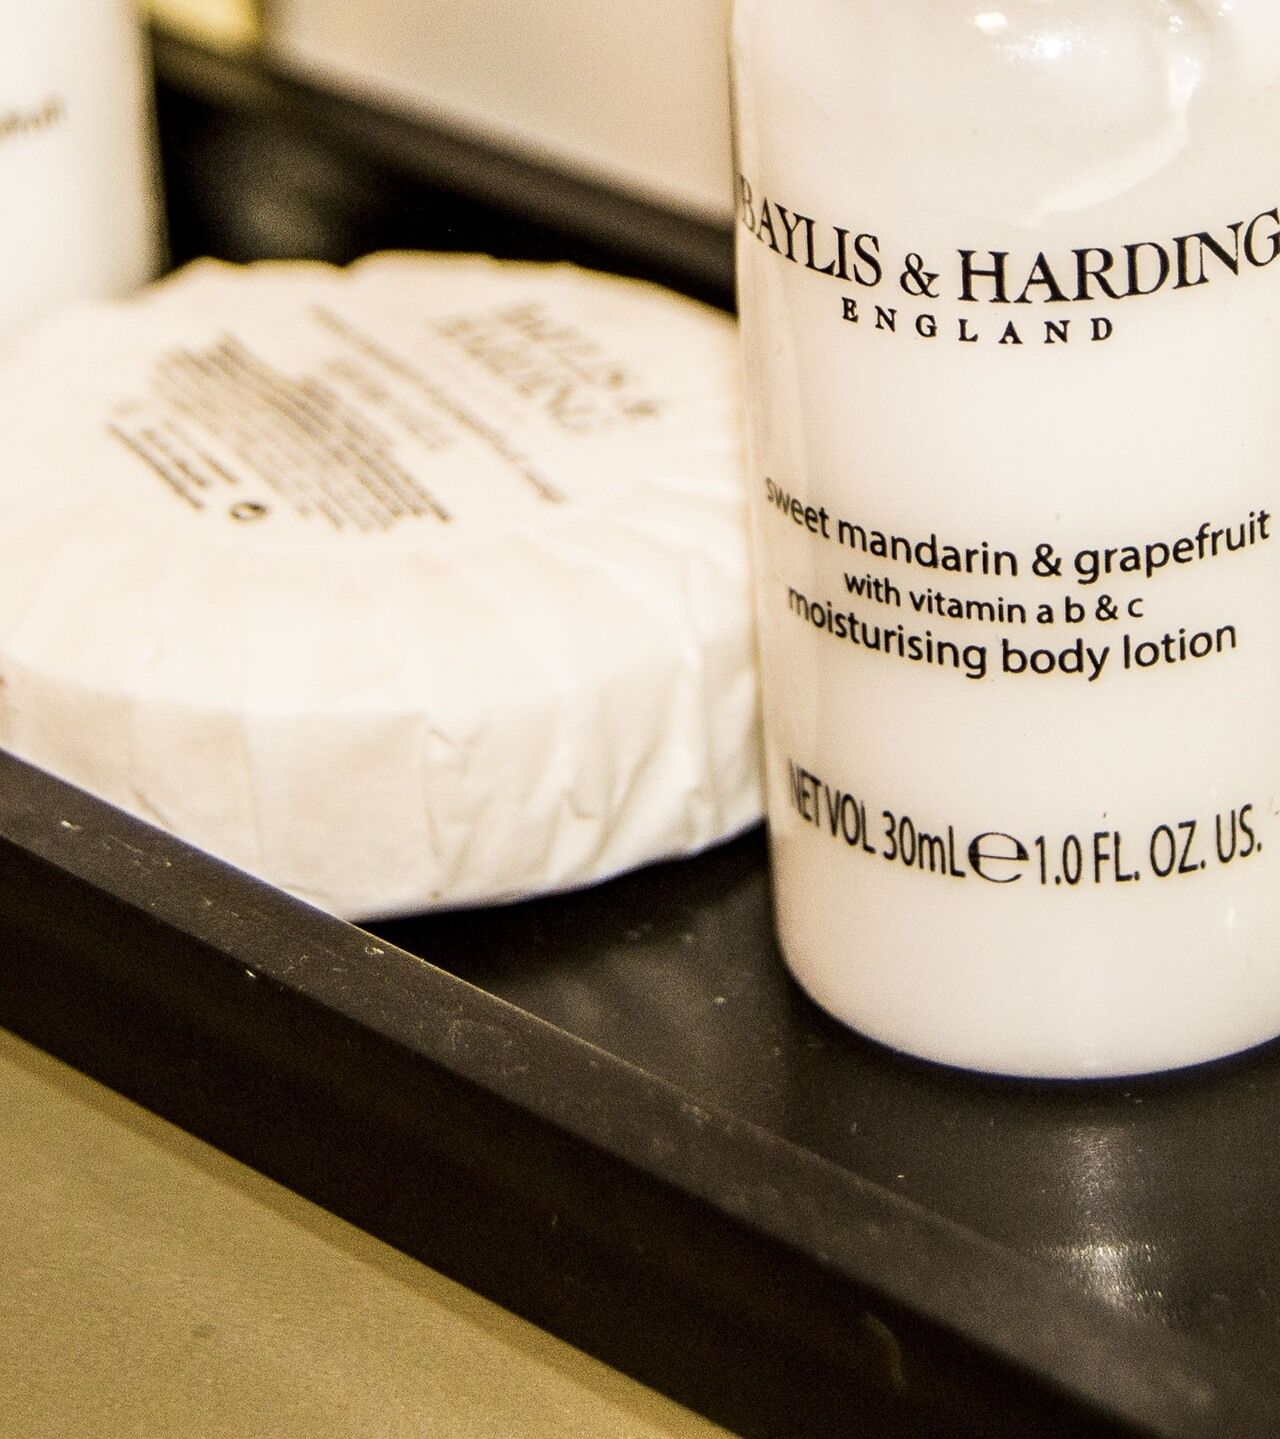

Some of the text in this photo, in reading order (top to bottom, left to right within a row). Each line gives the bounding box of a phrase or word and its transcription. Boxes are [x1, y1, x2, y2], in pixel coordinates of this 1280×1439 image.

[899, 252, 940, 299] &
[840, 296, 1114, 345] ENGLAND
[765, 476, 1271, 586] sweet mandarin & grapefruit
[843, 571, 1145, 625] with vitamin a b & c
[787, 585, 1238, 683] moisturising body lotion
[1093, 830, 1141, 884] FL.
[1149, 818, 1208, 879] OZ.
[1215, 802, 1263, 864] US.
